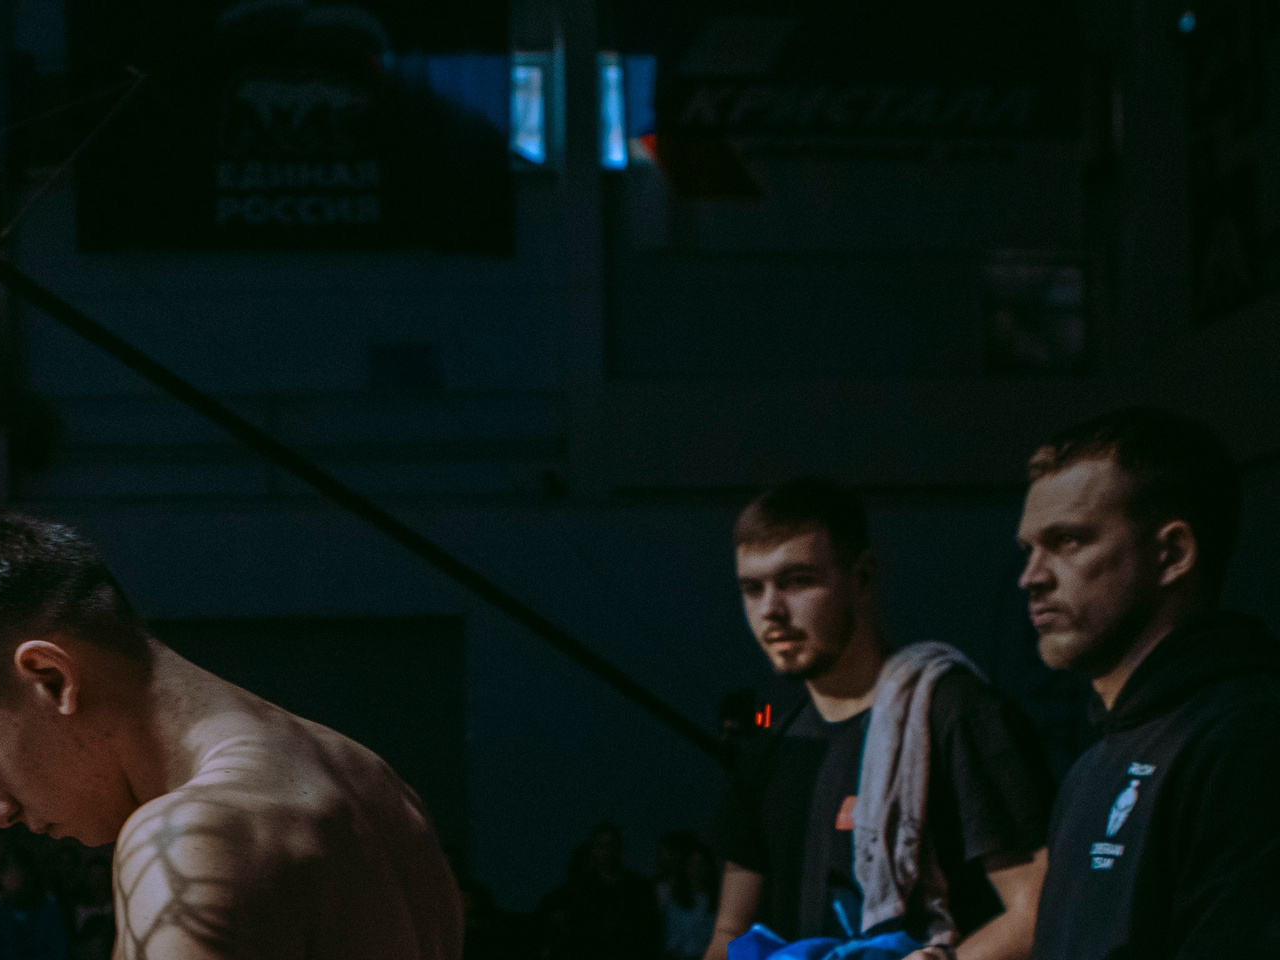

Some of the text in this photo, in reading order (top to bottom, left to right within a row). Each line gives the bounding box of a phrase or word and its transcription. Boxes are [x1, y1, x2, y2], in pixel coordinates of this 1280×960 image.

[680, 86, 1039, 127] КРИСТАЛЛ
[216, 161, 379, 190] ЕДИНАЯ
[216, 195, 380, 226] РОССИЯ
